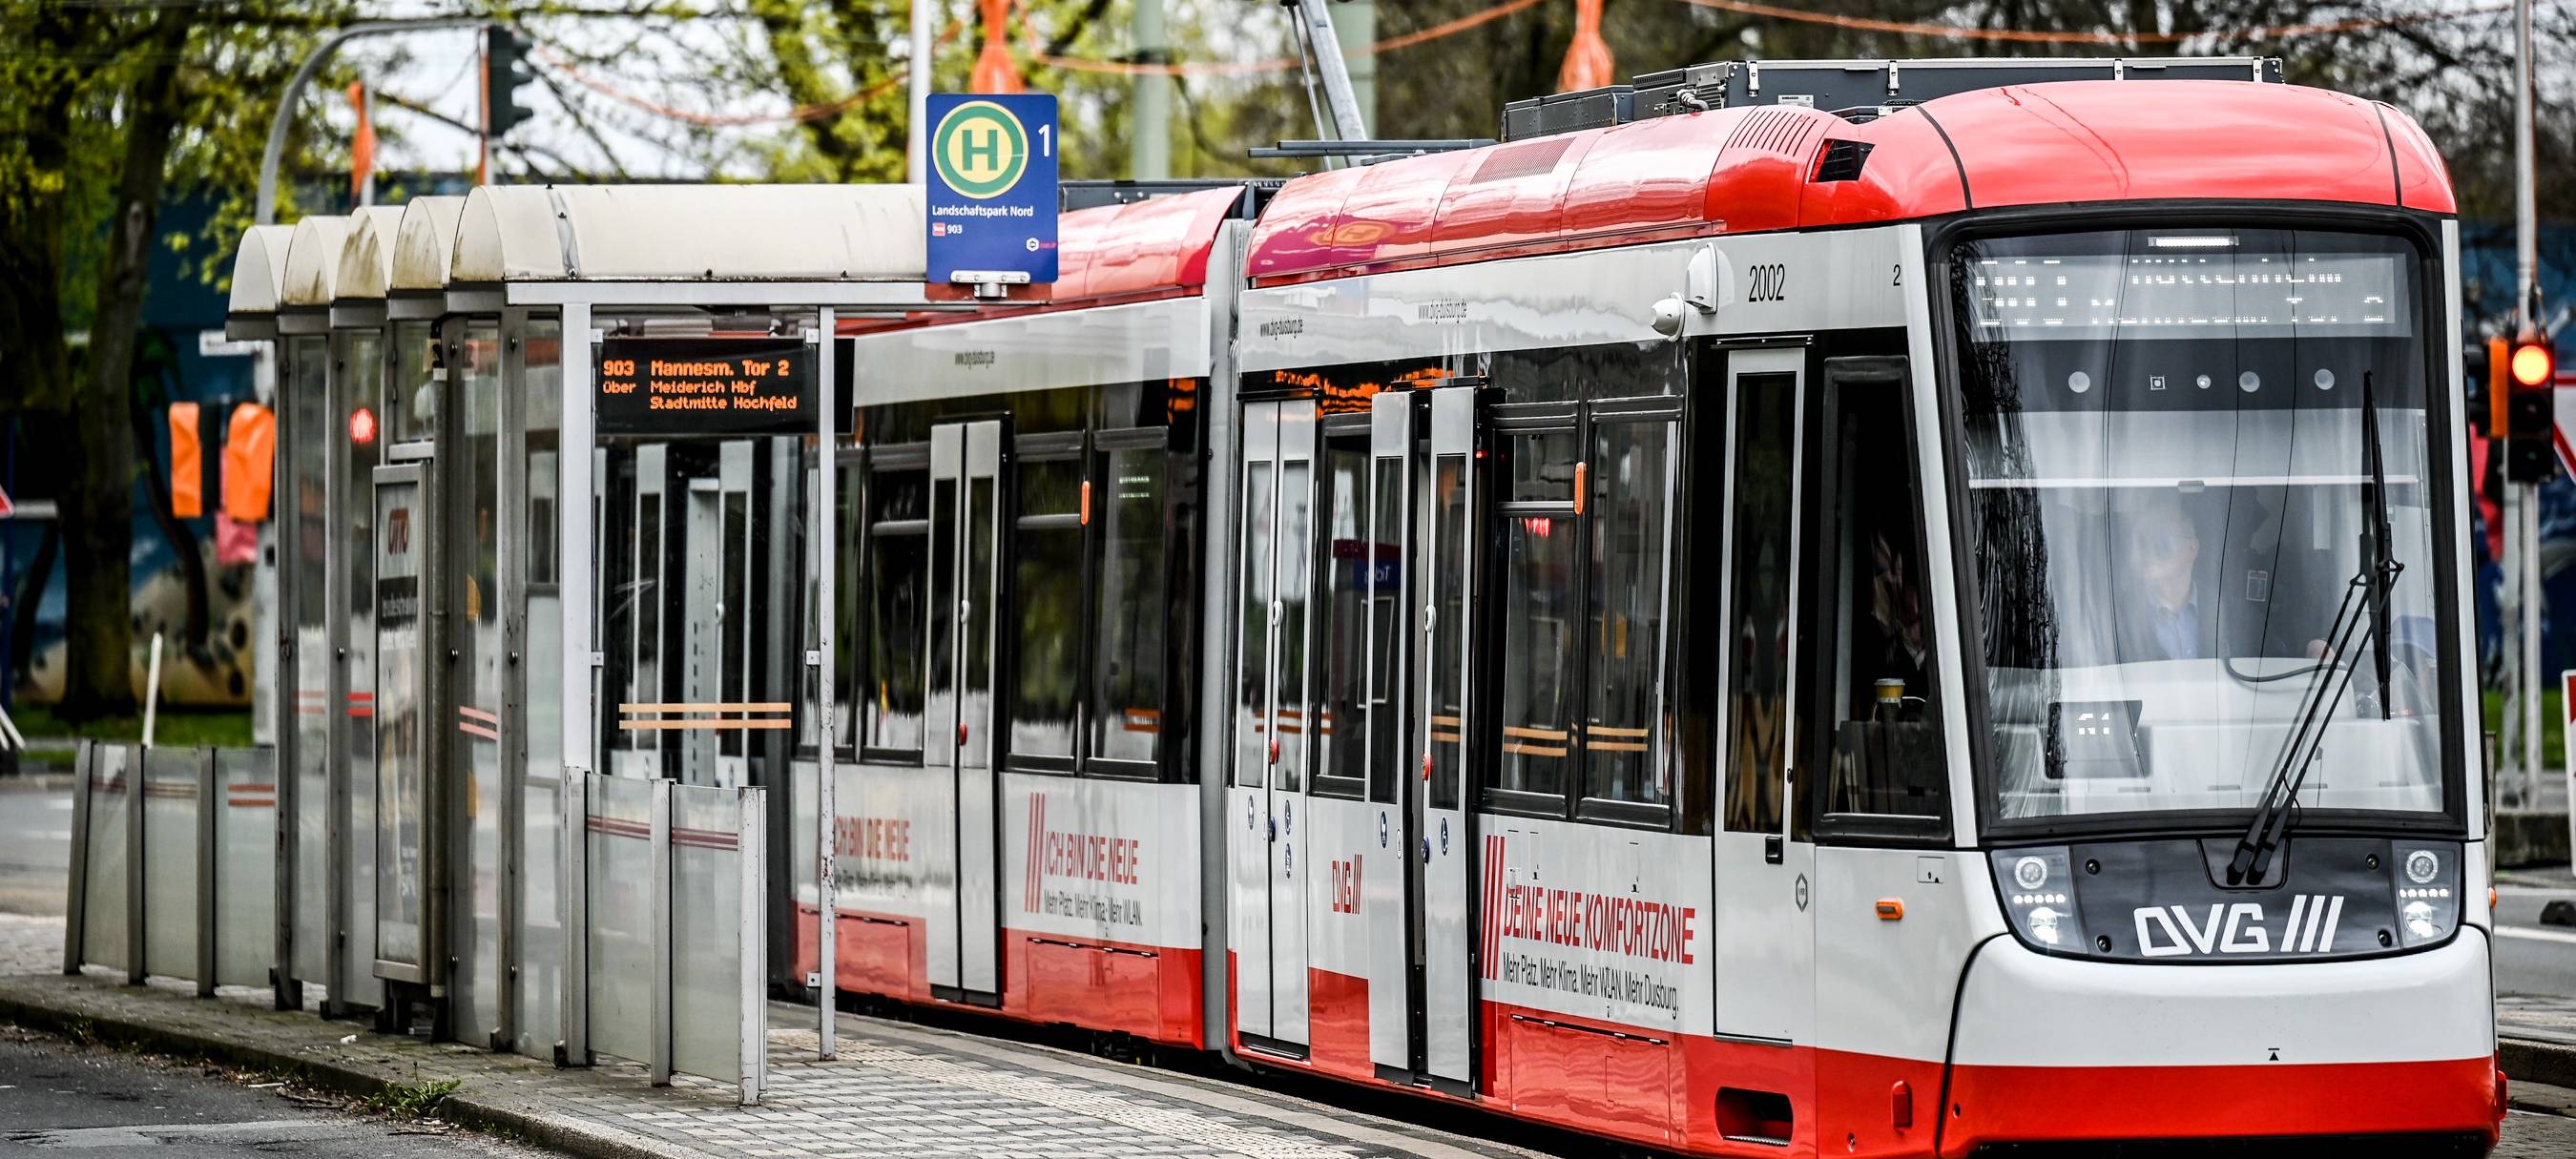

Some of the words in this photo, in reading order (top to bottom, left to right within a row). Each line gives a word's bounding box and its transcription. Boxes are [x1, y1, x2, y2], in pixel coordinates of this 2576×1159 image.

[962, 130, 998, 171] H
[1038, 124, 1049, 157] 1
[932, 204, 1008, 218] Landschaftspark
[1009, 206, 1034, 217] Nord
[946, 224, 963, 235] 903
[1748, 263, 1786, 302] 2002
[1892, 263, 1901, 286] 2
[603, 360, 634, 377] 903
[650, 360, 735, 377] Mannesm.
[742, 360, 770, 376] Tor
[778, 360, 790, 377] 2
[650, 382, 726, 394] Meiderich
[731, 381, 757, 396] Hbf
[650, 396, 728, 410] Stadtmitte
[734, 396, 798, 412] Hochfeld
[866, 817, 883, 859] DIE
[884, 818, 910, 862] NEUE
[1045, 831, 1064, 876] ICH
[1066, 833, 1085, 878] BIN
[1087, 835, 1106, 880] DIE
[1108, 838, 1138, 885] NEUE
[1075, 893, 1090, 919] Mehr
[1123, 899, 1143, 926] WLAN.
[1504, 883, 1543, 941] DEINE
[1546, 888, 1581, 946] NEUE
[1585, 894, 1695, 964] KOMFORTZONE
[2133, 902, 2270, 957] DVG
[1504, 952, 1520, 983] Mehr
[1522, 955, 1538, 986] Platz.
[1541, 957, 1557, 989] Mehr
[1558, 960, 1579, 993] Klima.
[1581, 963, 1598, 997] Mehr
[1600, 966, 1623, 1001] WLAN.
[1625, 970, 1643, 1004] Mehr
[1645, 974, 1679, 1020] Duisburg.
